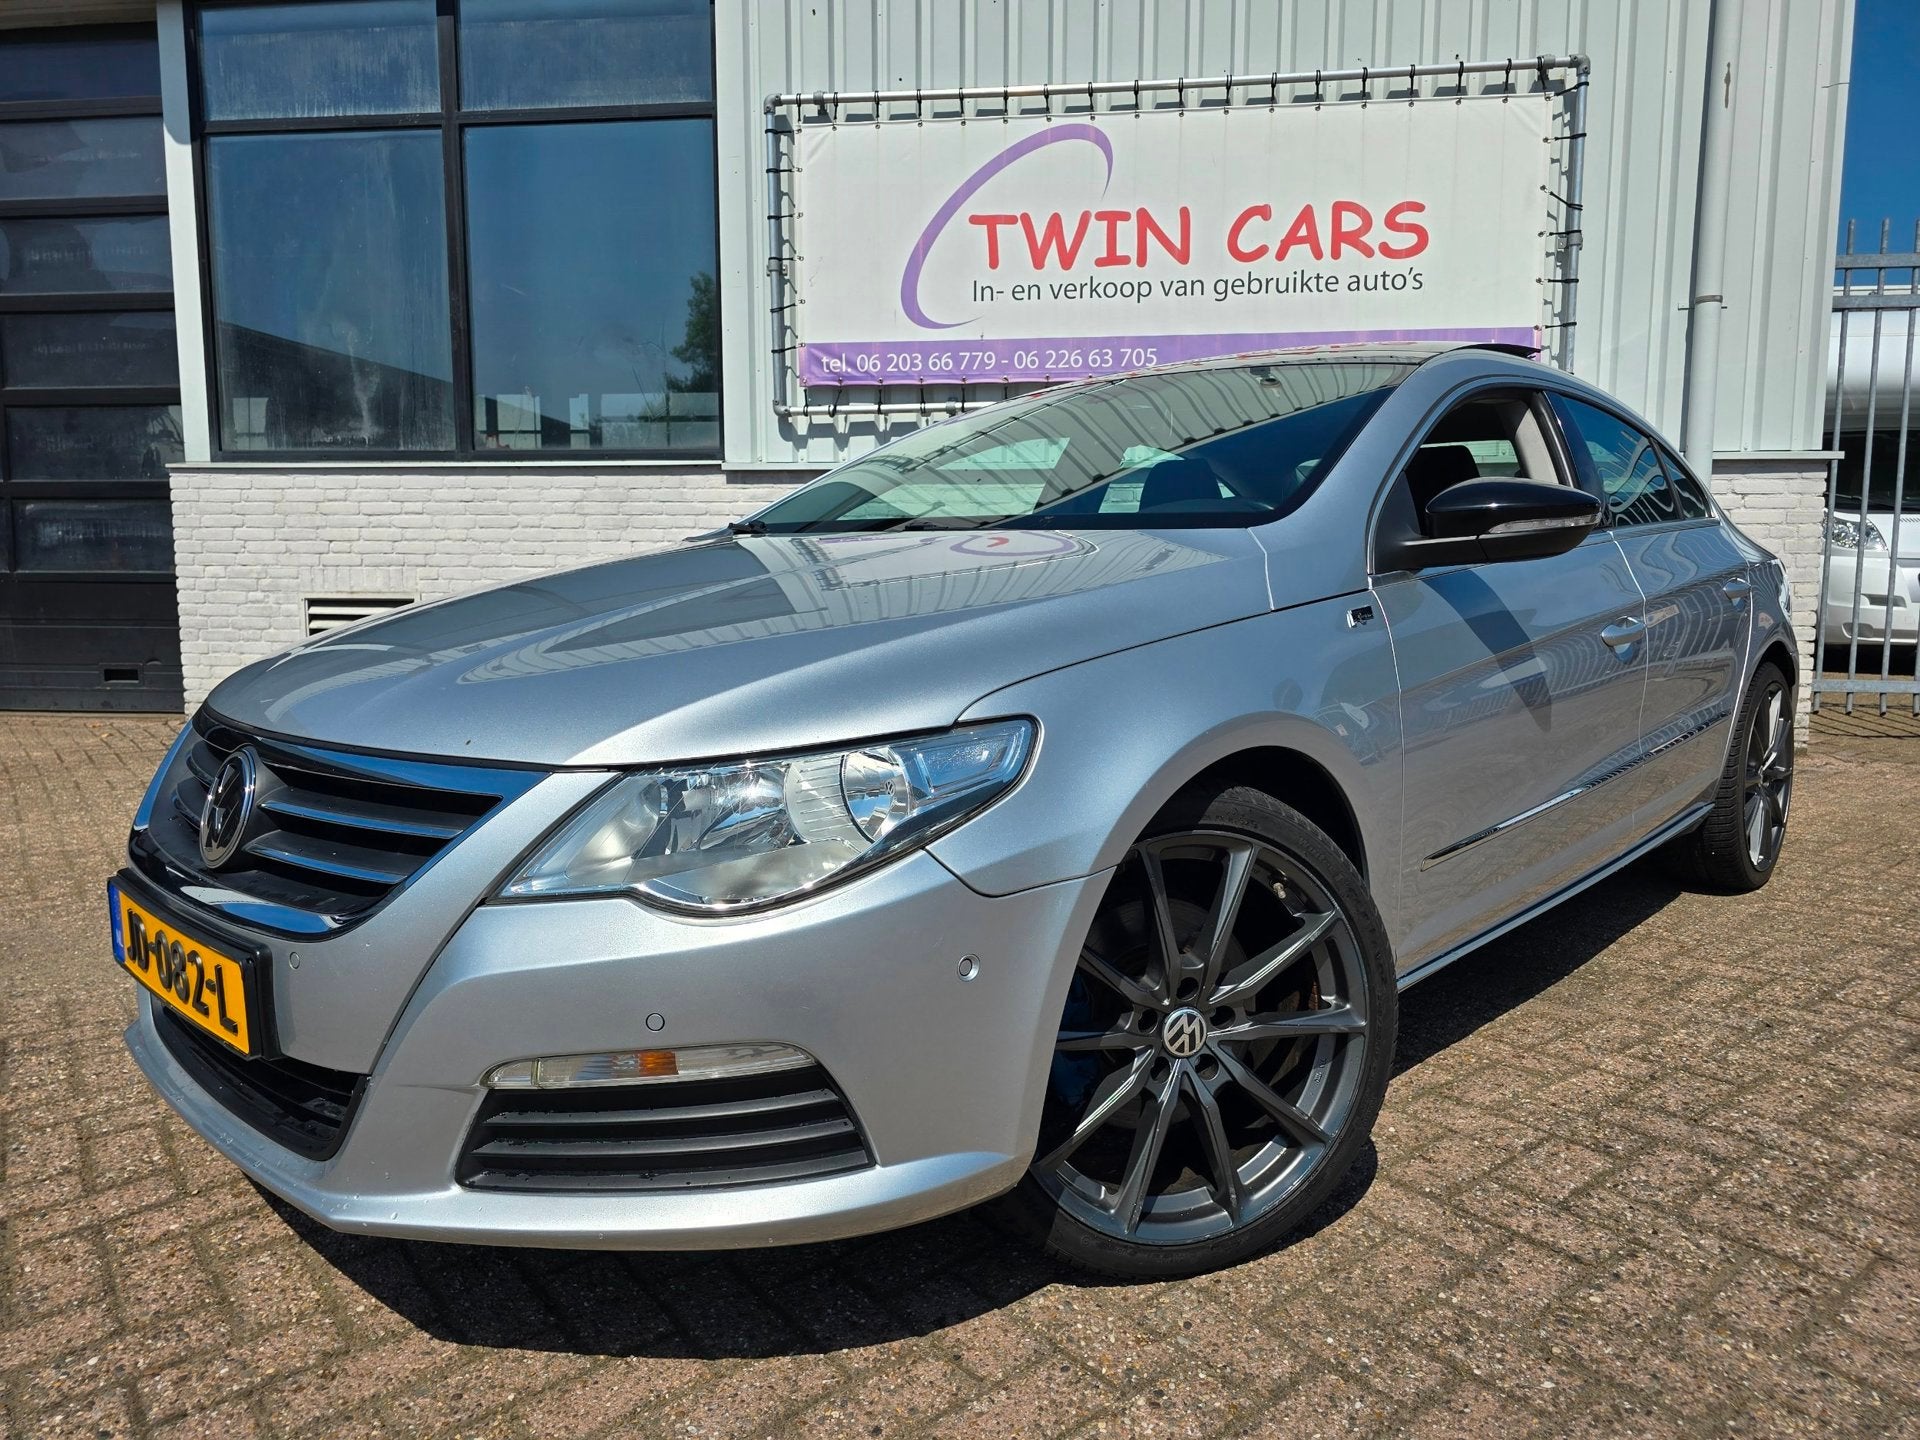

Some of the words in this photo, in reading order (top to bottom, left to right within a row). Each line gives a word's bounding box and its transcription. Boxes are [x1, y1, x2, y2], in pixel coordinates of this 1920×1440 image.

[969, 207, 1191, 271] TWIN
[1226, 200, 1430, 263] CARS
[973, 279, 1005, 302] In-
[1011, 284, 1041, 301] en
[1049, 275, 1153, 305] verkoop
[1159, 279, 1205, 297] van
[1213, 269, 1340, 303] gebruikte
[821, 353, 853, 374] tel.
[856, 353, 881, 372] 06
[886, 352, 923, 372] 203
[928, 352, 954, 371] 66
[959, 350, 996, 371] 779
[1013, 350, 1040, 370] 06
[1044, 349, 1083, 369] 226
[1088, 348, 1113, 368] 63
[1119, 347, 1158, 367] 705
[126, 907, 239, 1037] JD-082-L
